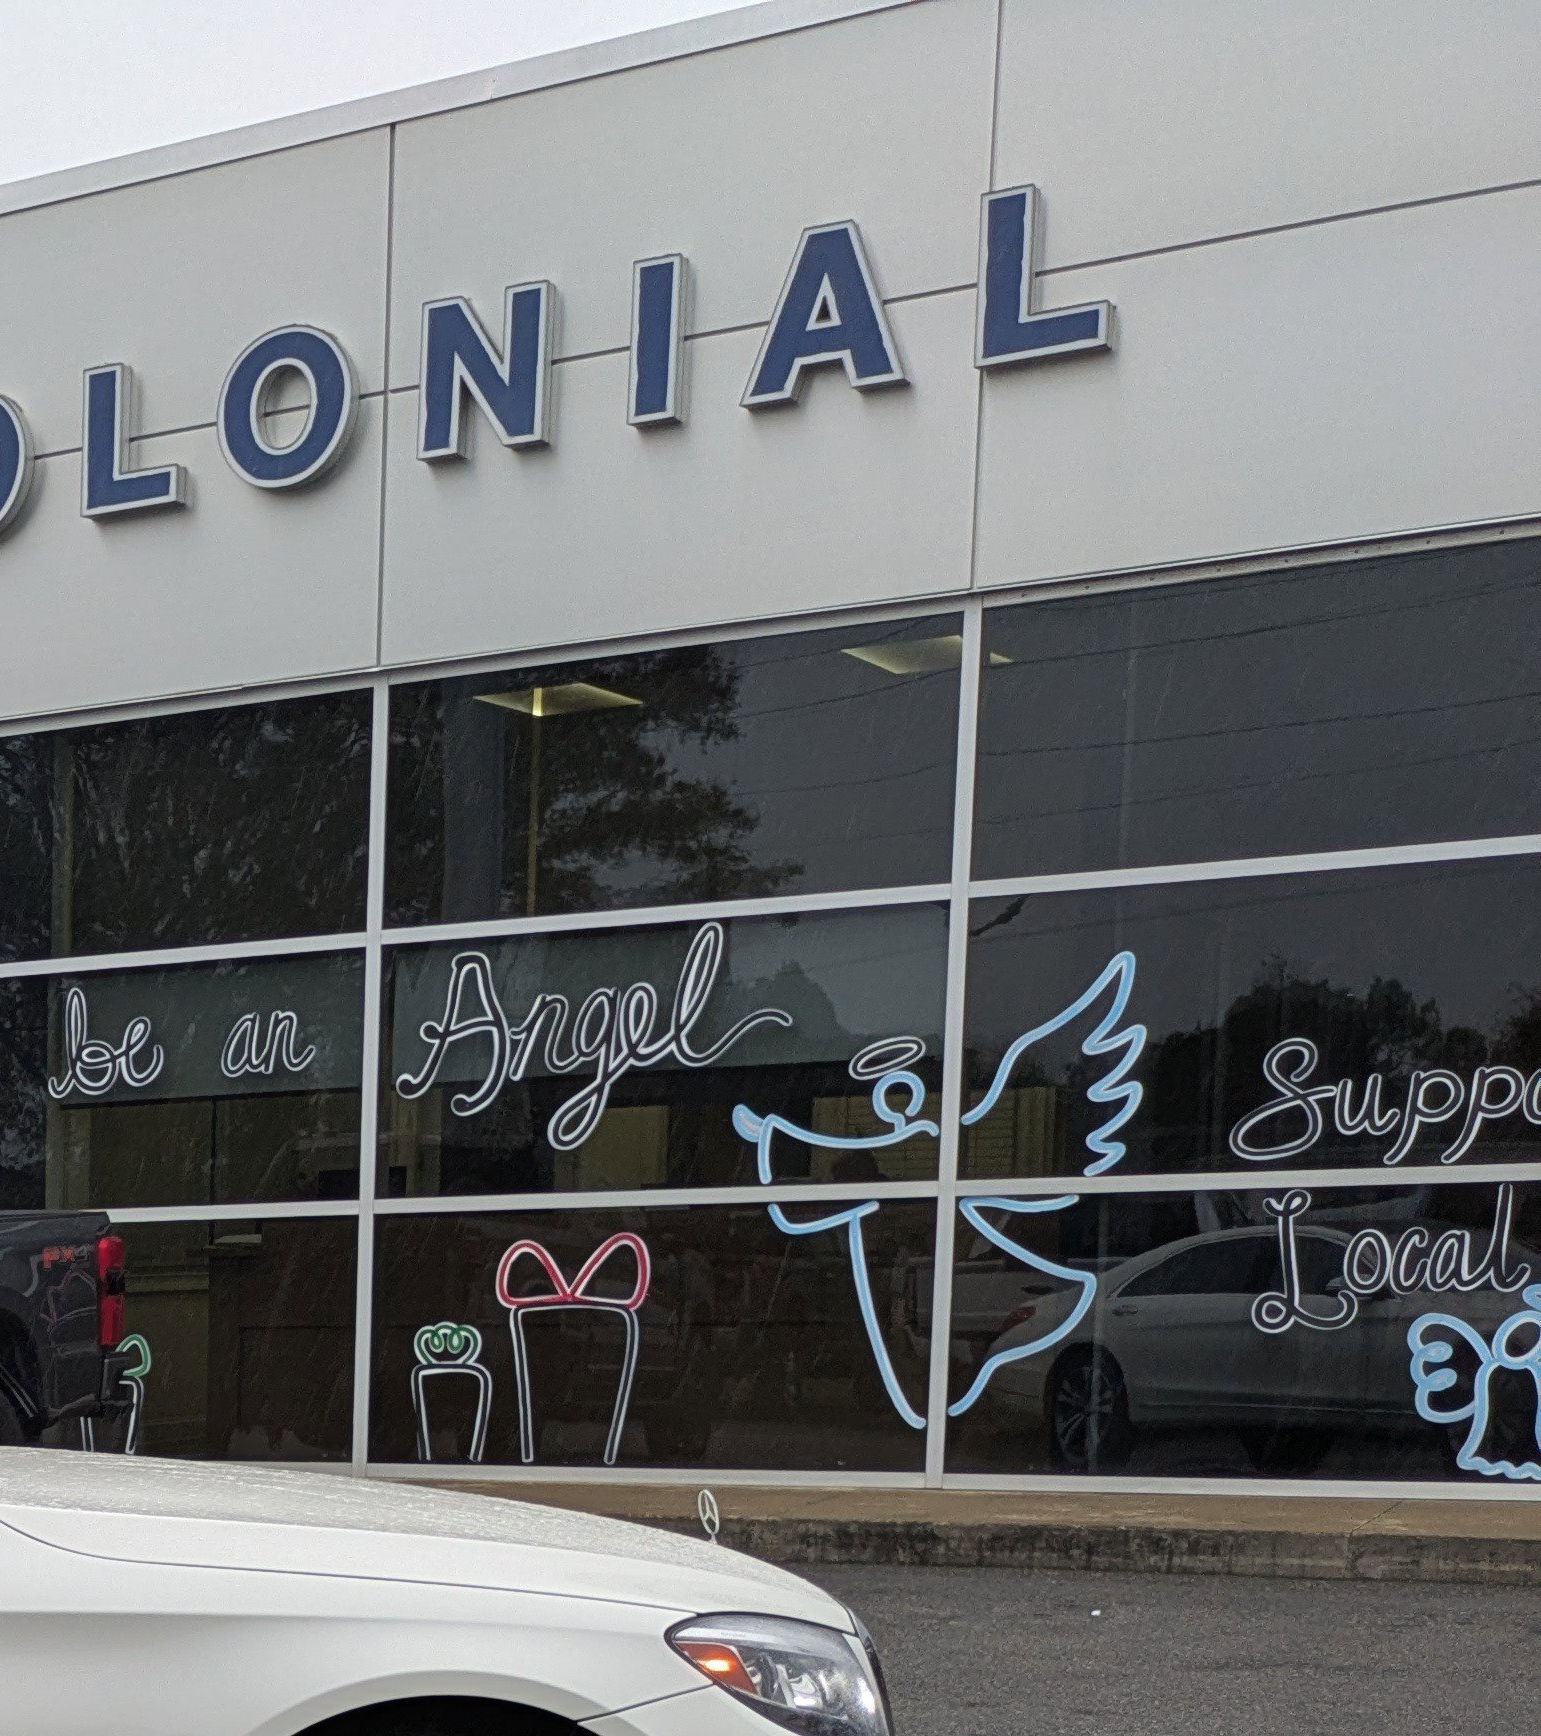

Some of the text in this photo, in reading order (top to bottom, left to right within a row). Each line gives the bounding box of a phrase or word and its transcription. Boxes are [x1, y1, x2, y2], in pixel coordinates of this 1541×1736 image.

[48, 920, 793, 1152] be an Angel
[1251, 1183, 1531, 1334] Local
